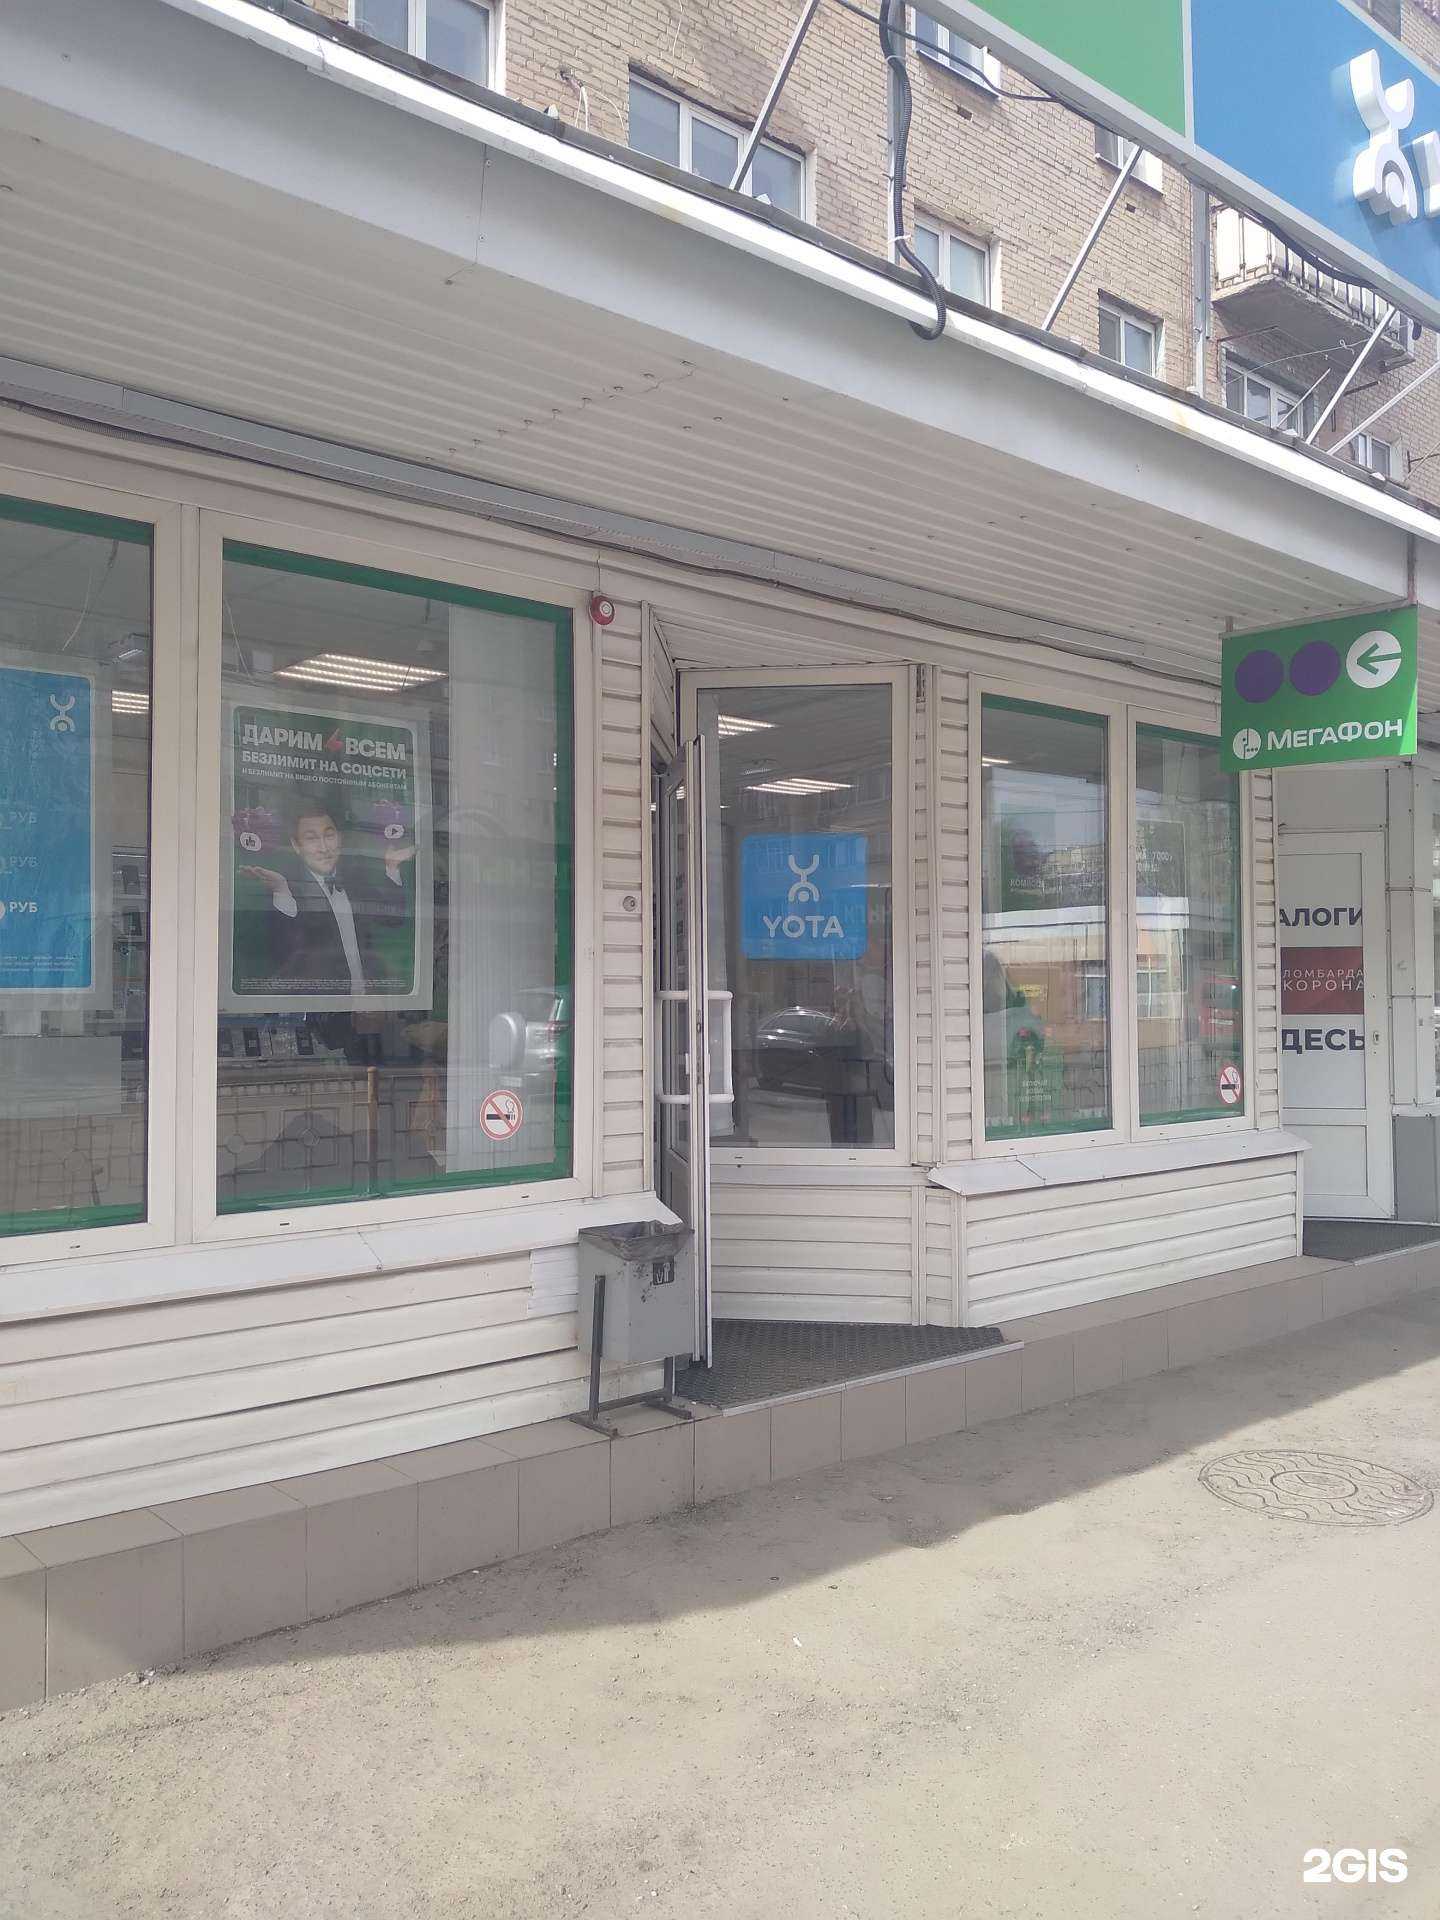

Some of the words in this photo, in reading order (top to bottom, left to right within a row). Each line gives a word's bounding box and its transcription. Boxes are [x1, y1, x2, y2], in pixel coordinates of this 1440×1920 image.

[1267, 718, 1403, 751] МЕГАФОН
[242, 724, 323, 751] ДАРИМ
[345, 737, 406, 761] ВСЕМ
[242, 750, 317, 770] БЕЗЛИМИТ
[319, 760, 338, 773] НА
[341, 763, 407, 780] СОЦСЕТИ
[9, 811, 38, 824] РУБ
[9, 855, 39, 868] РУБ
[9, 901, 38, 913] РУБ
[762, 915, 844, 939] YOTA
[1282, 968, 1364, 980] ЛОМБАРДА
[1283, 979, 1364, 991] КОРОНА
